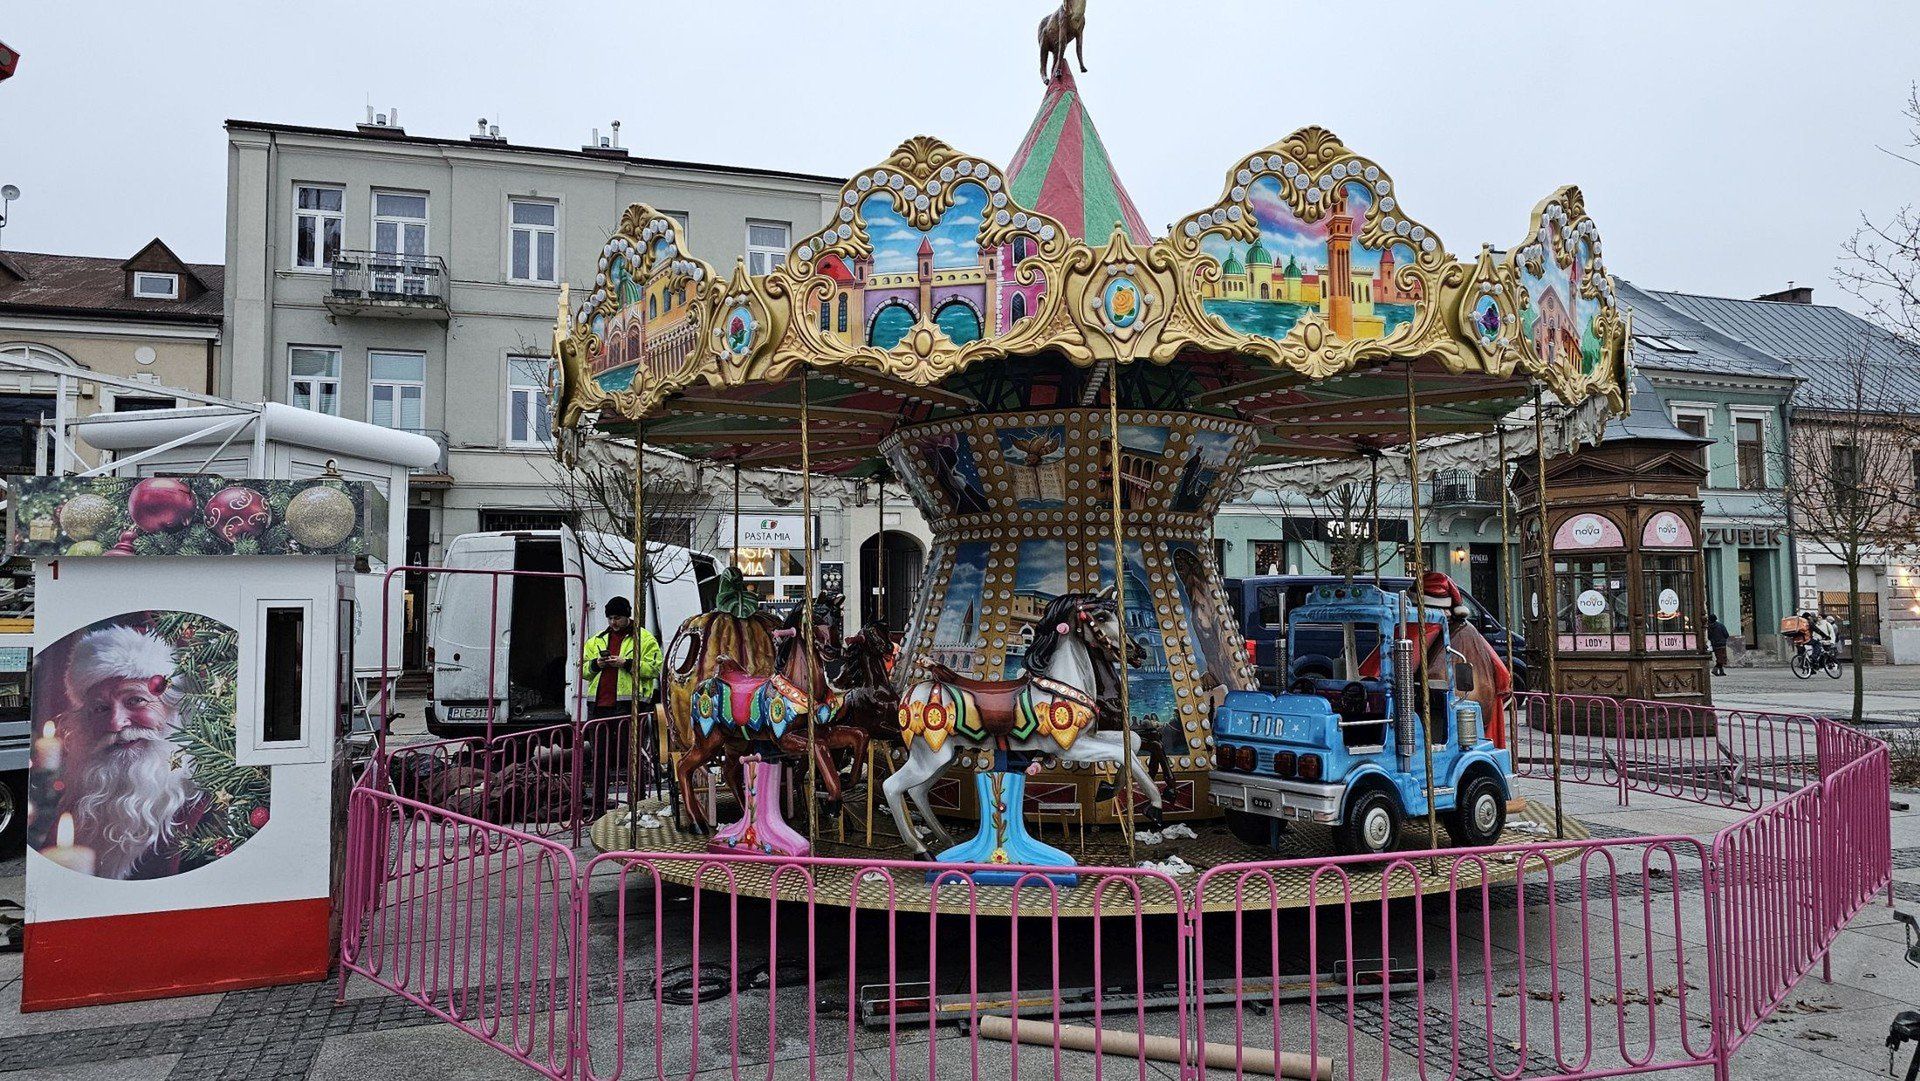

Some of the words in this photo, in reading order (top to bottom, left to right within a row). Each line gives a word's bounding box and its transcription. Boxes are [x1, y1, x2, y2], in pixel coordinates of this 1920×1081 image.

[745, 532, 772, 541] PASTA
[775, 532, 791, 541] MIA
[1575, 528, 1600, 536] nova
[730, 547, 774, 559] ASTA
[48, 560, 59, 580] 1
[738, 561, 765, 575] MIA
[1585, 638, 1603, 648] LODY
[1664, 637, 1678, 647] LODY
[1251, 714, 1284, 737] TIR
